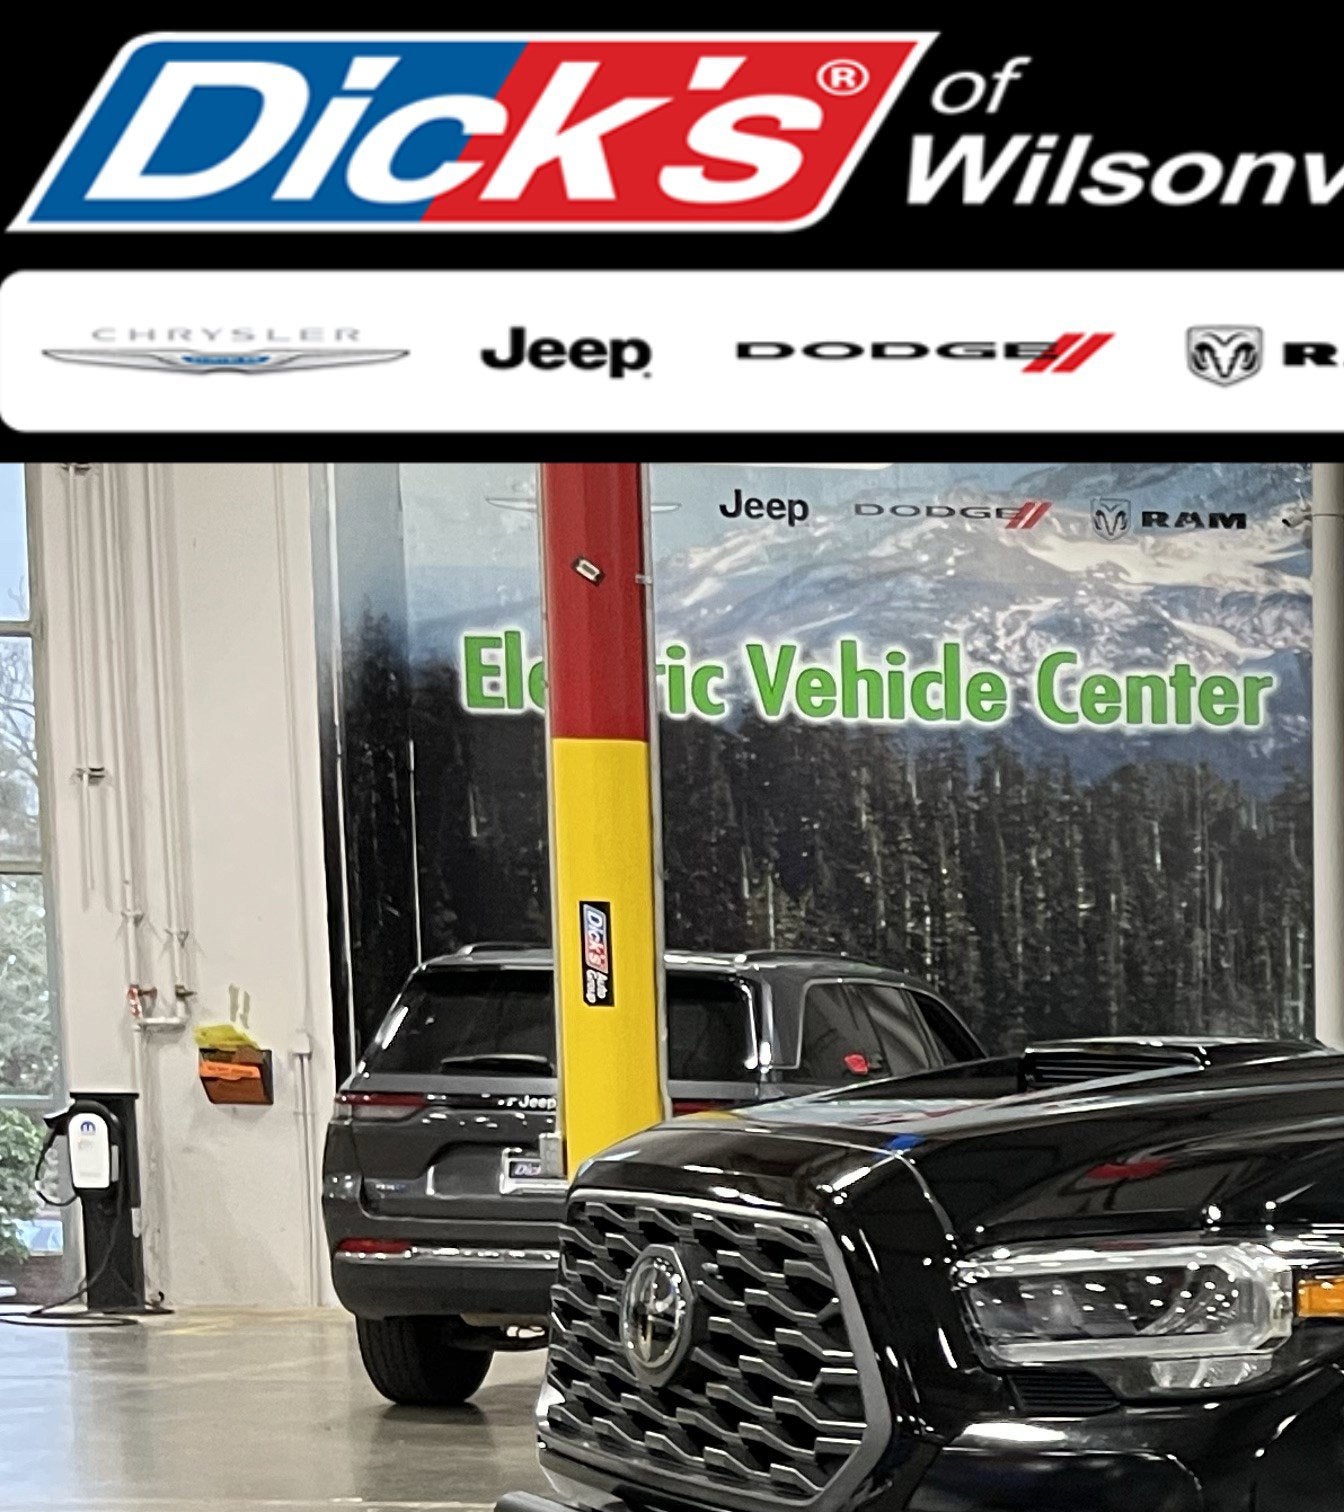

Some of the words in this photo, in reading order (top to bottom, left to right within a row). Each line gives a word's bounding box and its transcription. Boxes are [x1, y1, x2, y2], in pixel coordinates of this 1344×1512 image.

[719, 489, 809, 527] Jeep
[854, 502, 1020, 520] DODGE
[1141, 510, 1248, 530] RAM
[746, 639, 1008, 722] Vehicle
[1037, 651, 1274, 726] Center
[518, 1094, 557, 1110] Jeep
